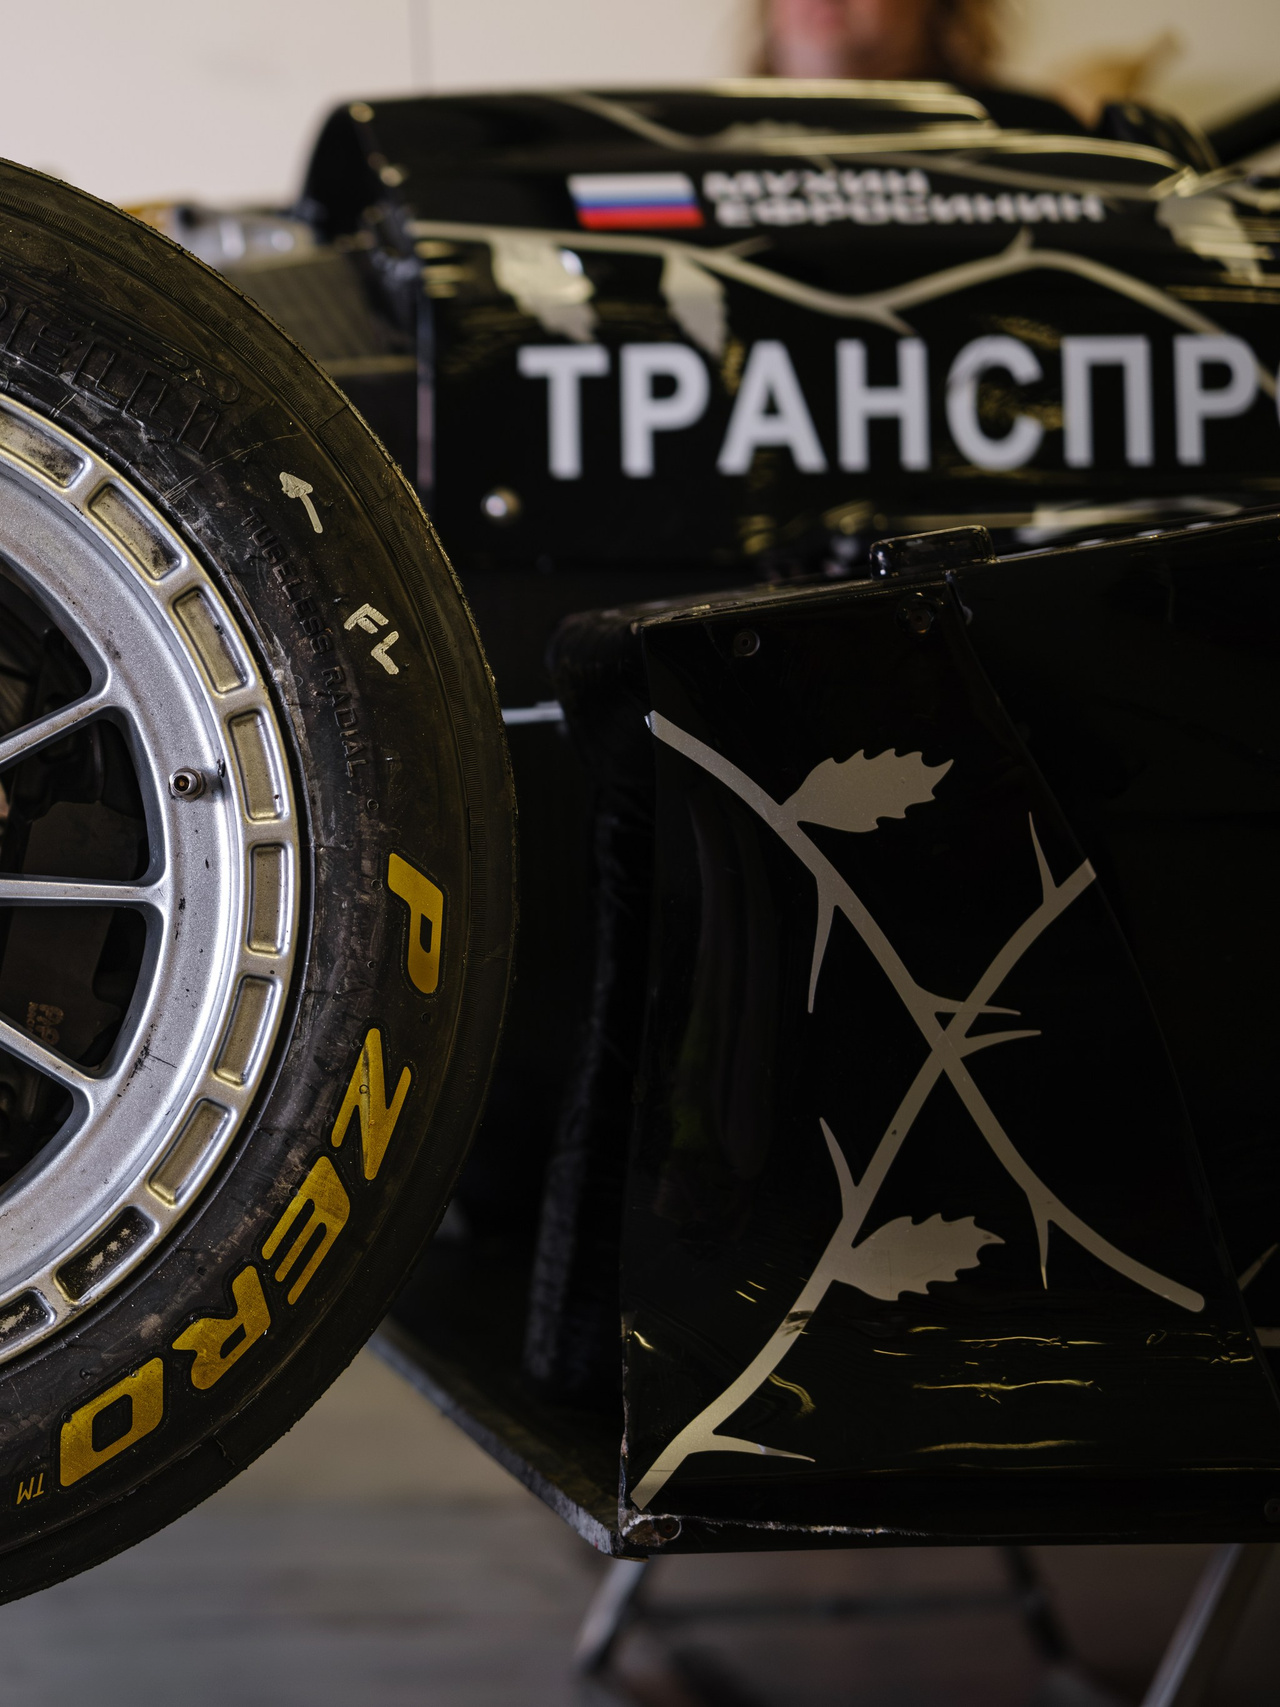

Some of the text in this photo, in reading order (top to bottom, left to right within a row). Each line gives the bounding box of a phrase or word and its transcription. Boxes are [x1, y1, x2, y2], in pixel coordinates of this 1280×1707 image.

[517, 334, 1280, 481] ТРАНСПР
[241, 506, 368, 778] TUBELESS RADIAL
[344, 603, 400, 675] FL
[387, 852, 445, 994] P
[60, 1027, 412, 1487] ZERO
